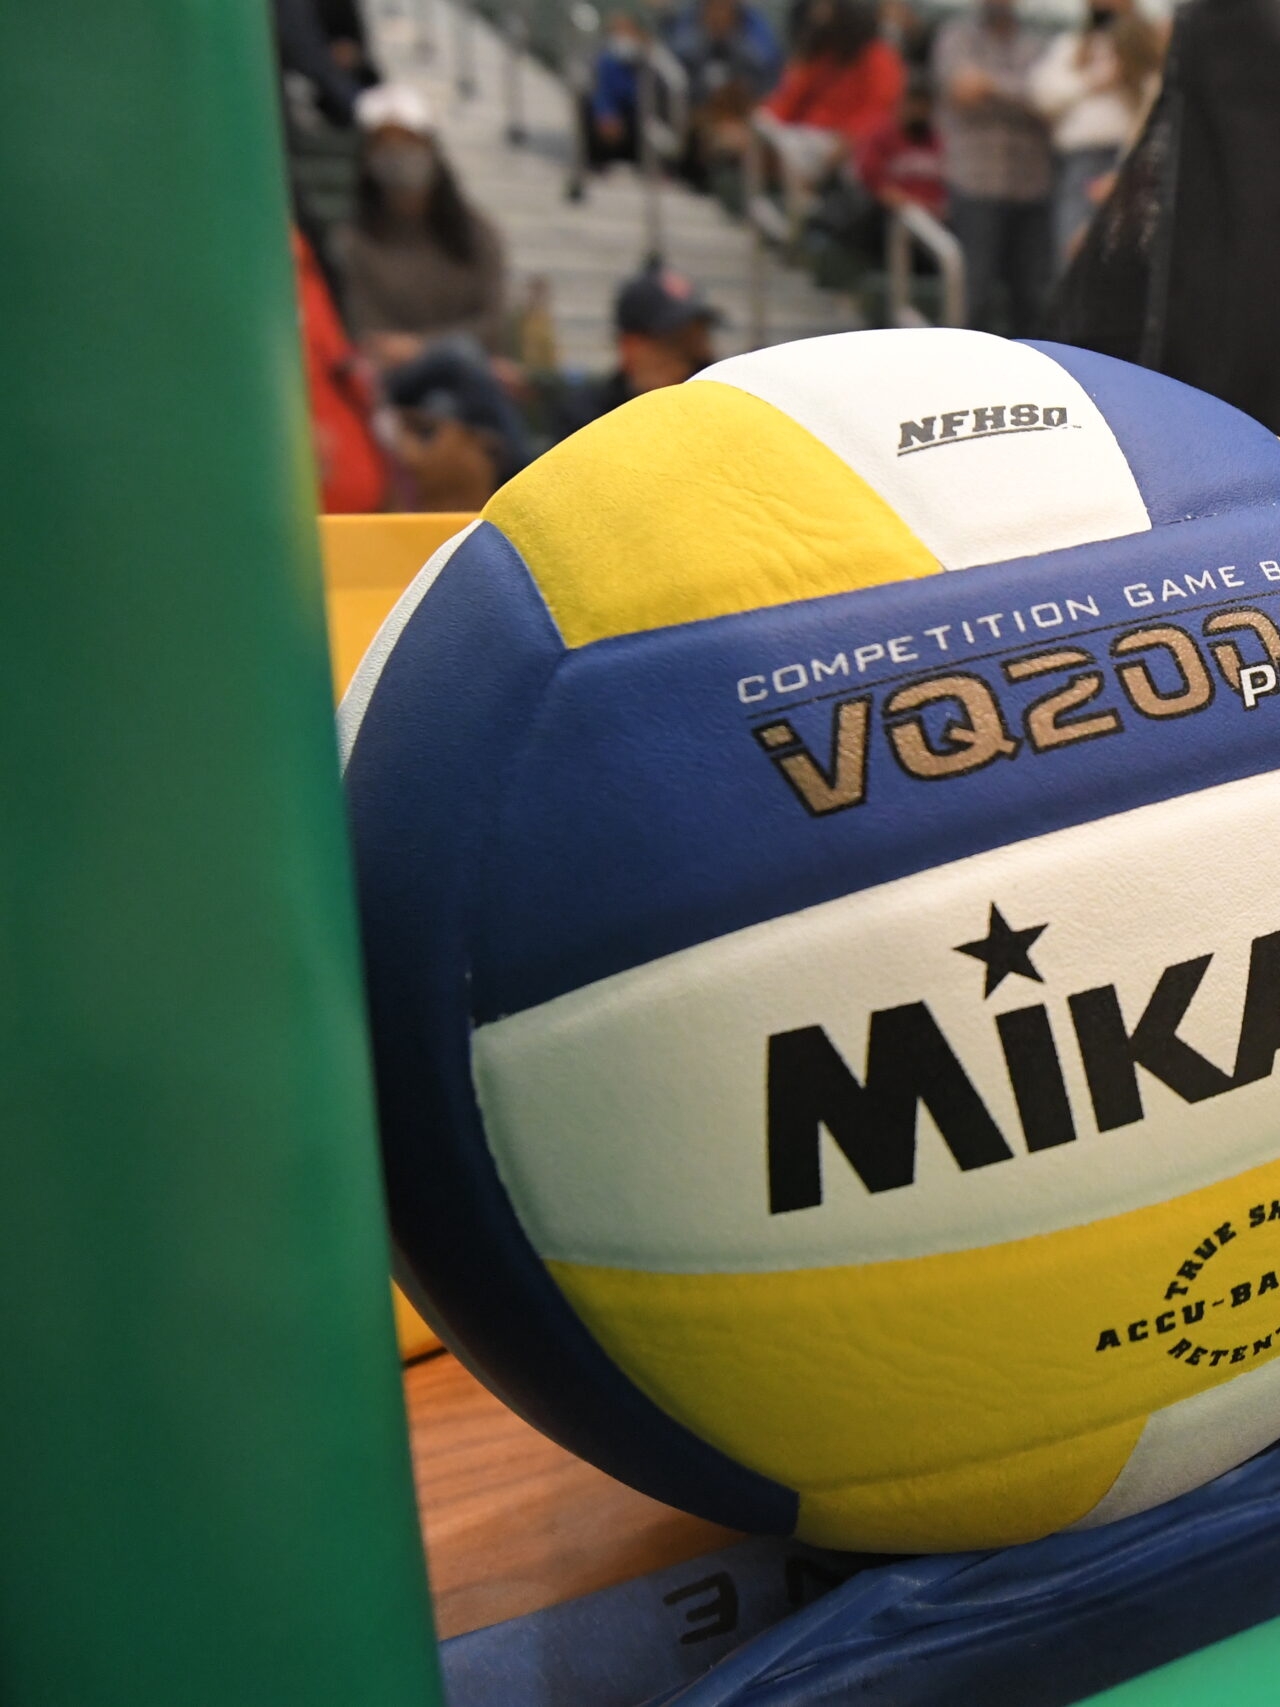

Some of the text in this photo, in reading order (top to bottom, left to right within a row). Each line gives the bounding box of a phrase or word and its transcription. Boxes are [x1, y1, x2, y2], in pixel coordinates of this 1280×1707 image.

[737, 594, 1099, 703] COMPETITION
[1124, 565, 1244, 608] GAME
[1164, 1222, 1236, 1301] TRUE
